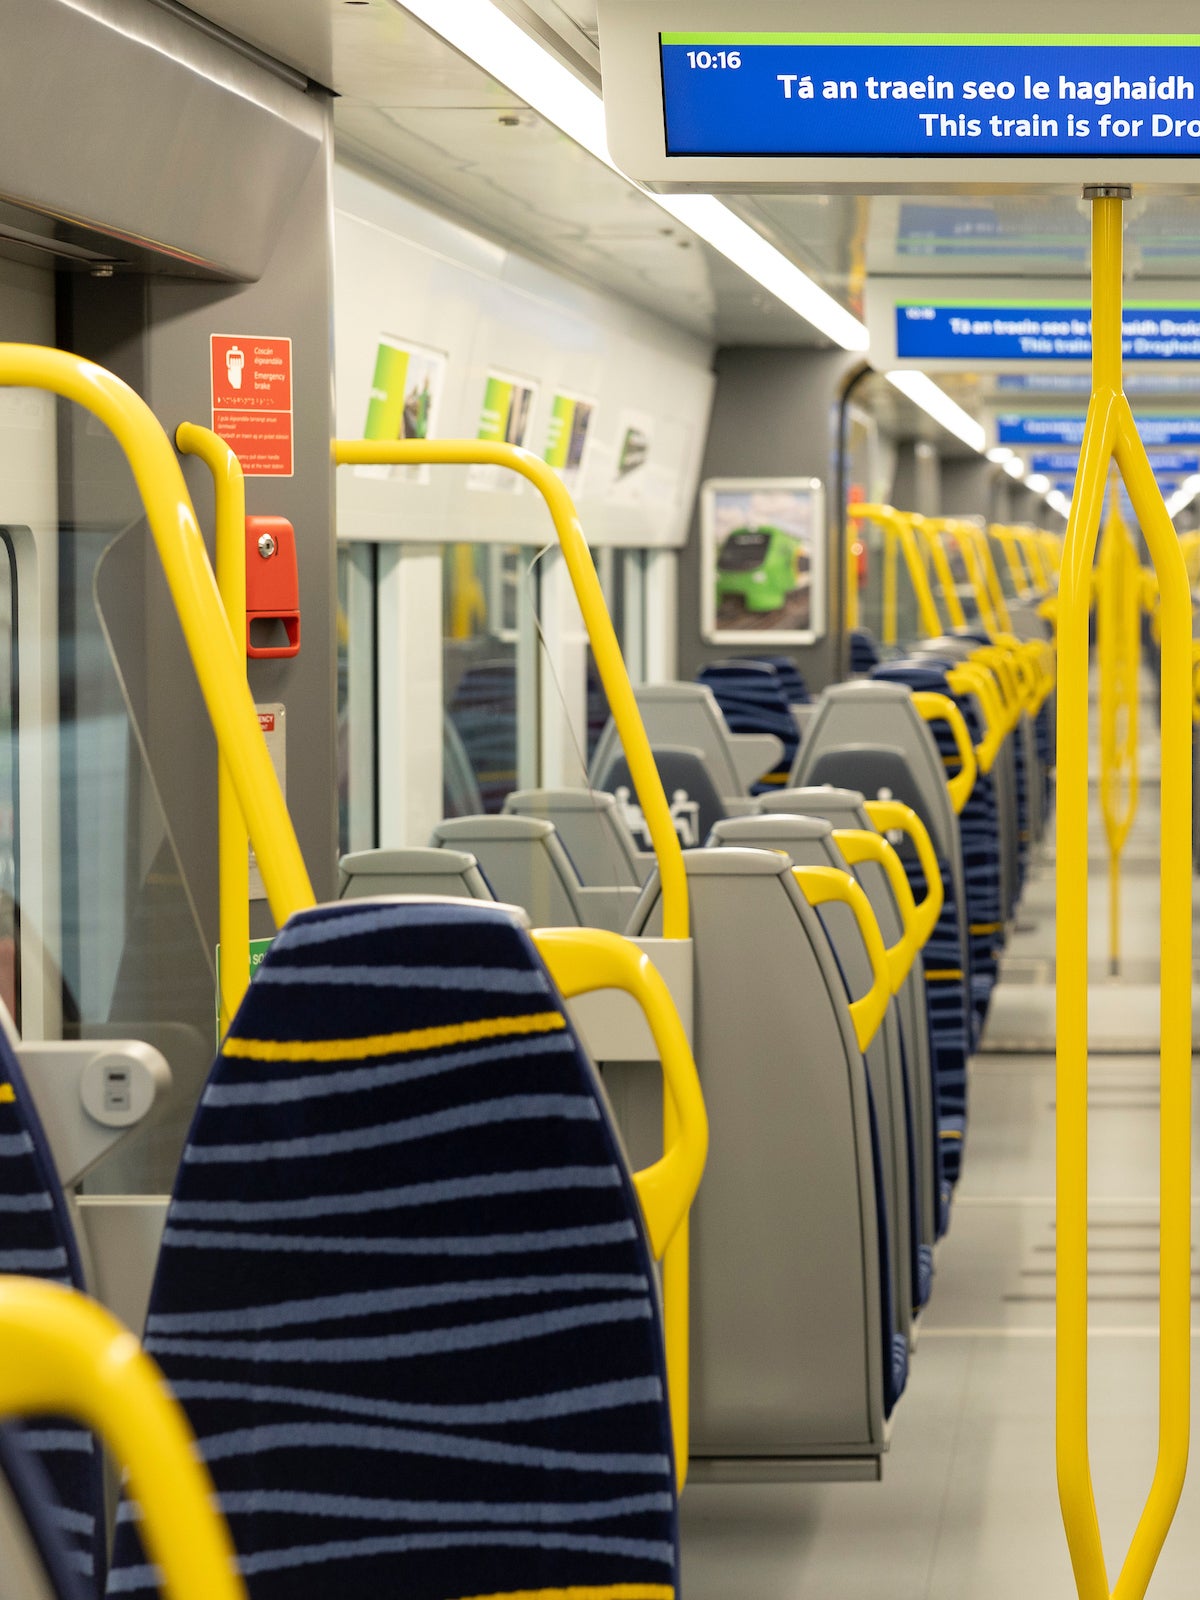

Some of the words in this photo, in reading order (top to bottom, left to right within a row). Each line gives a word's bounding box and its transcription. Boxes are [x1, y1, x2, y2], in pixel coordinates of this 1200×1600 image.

[686, 51, 742, 69] 10:16
[776, 74, 815, 100] Tá
[822, 80, 858, 100] an
[864, 74, 954, 100] traein
[962, 81, 1016, 100] seo
[1023, 75, 1050, 100] le
[1058, 75, 1195, 106] haghaidh
[918, 113, 982, 137] This
[988, 113, 1059, 137] train
[1067, 113, 1091, 138] is
[1097, 113, 1144, 138] for
[254, 372, 286, 382] Emergency
[254, 382, 271, 390] brake
